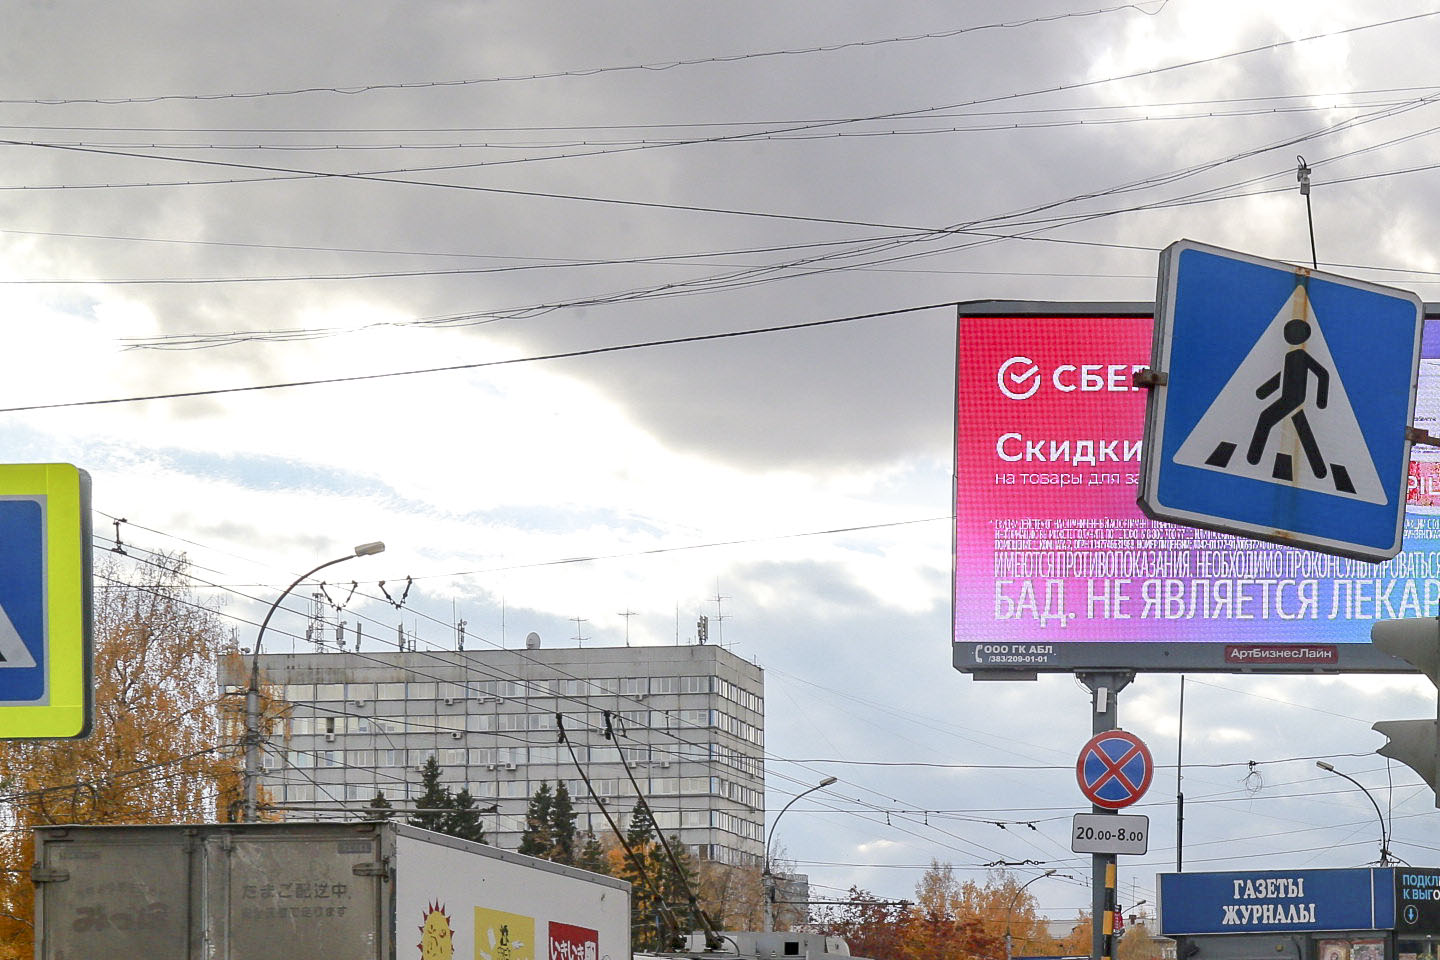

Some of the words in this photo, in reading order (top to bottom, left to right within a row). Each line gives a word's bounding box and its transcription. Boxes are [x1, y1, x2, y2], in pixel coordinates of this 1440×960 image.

[996, 432, 1142, 467] Скидки
[995, 472, 1015, 485] на
[1020, 473, 1083, 488] товары
[1088, 473, 1120, 487] для
[994, 551, 1053, 578] ИМЕЮТСЯ
[1055, 551, 1193, 578] ПРОТИВОПОКАЗАНИЯ.
[1196, 551, 1283, 579] НЕОБХОДИМО
[994, 579, 1076, 628] БАД.
[1087, 579, 1132, 619] НЕ
[1140, 579, 1319, 620] ЯВЛЯЕТСЯ
[984, 644, 1009, 654] ООО
[1012, 644, 1026, 654] ГК
[1029, 644, 1053, 655] АБЛ
[1231, 647, 1332, 660] АртБизнесЛайн
[1076, 826, 1143, 842] 20.00-8.00
[1233, 878, 1304, 899] ГАЗЕТЫ
[1403, 888, 1410, 900] К
[1222, 903, 1316, 925] ЖУРНАЛЫ
